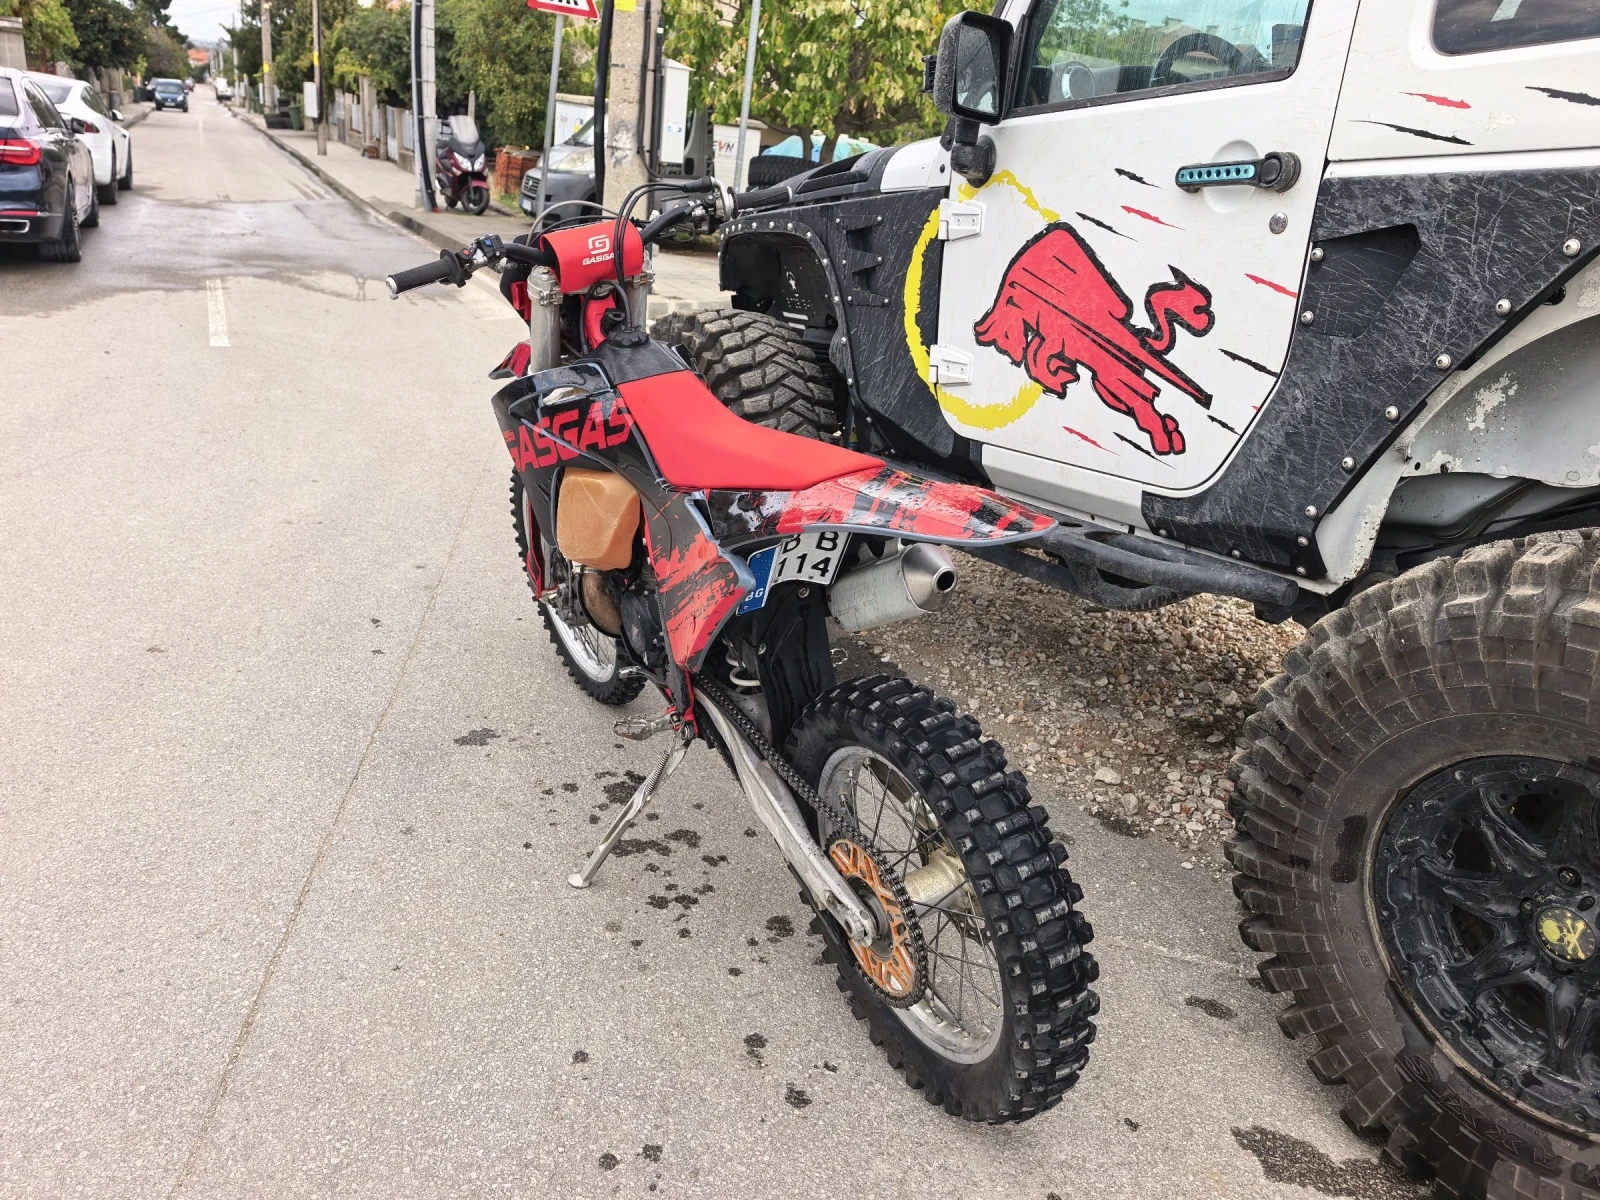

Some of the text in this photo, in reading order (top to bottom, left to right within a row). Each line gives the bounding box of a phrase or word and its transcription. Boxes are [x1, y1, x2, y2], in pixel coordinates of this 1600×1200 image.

[582, 252, 615, 265] GASGA
[815, 531, 839, 551] B
[777, 552, 832, 578] 114
